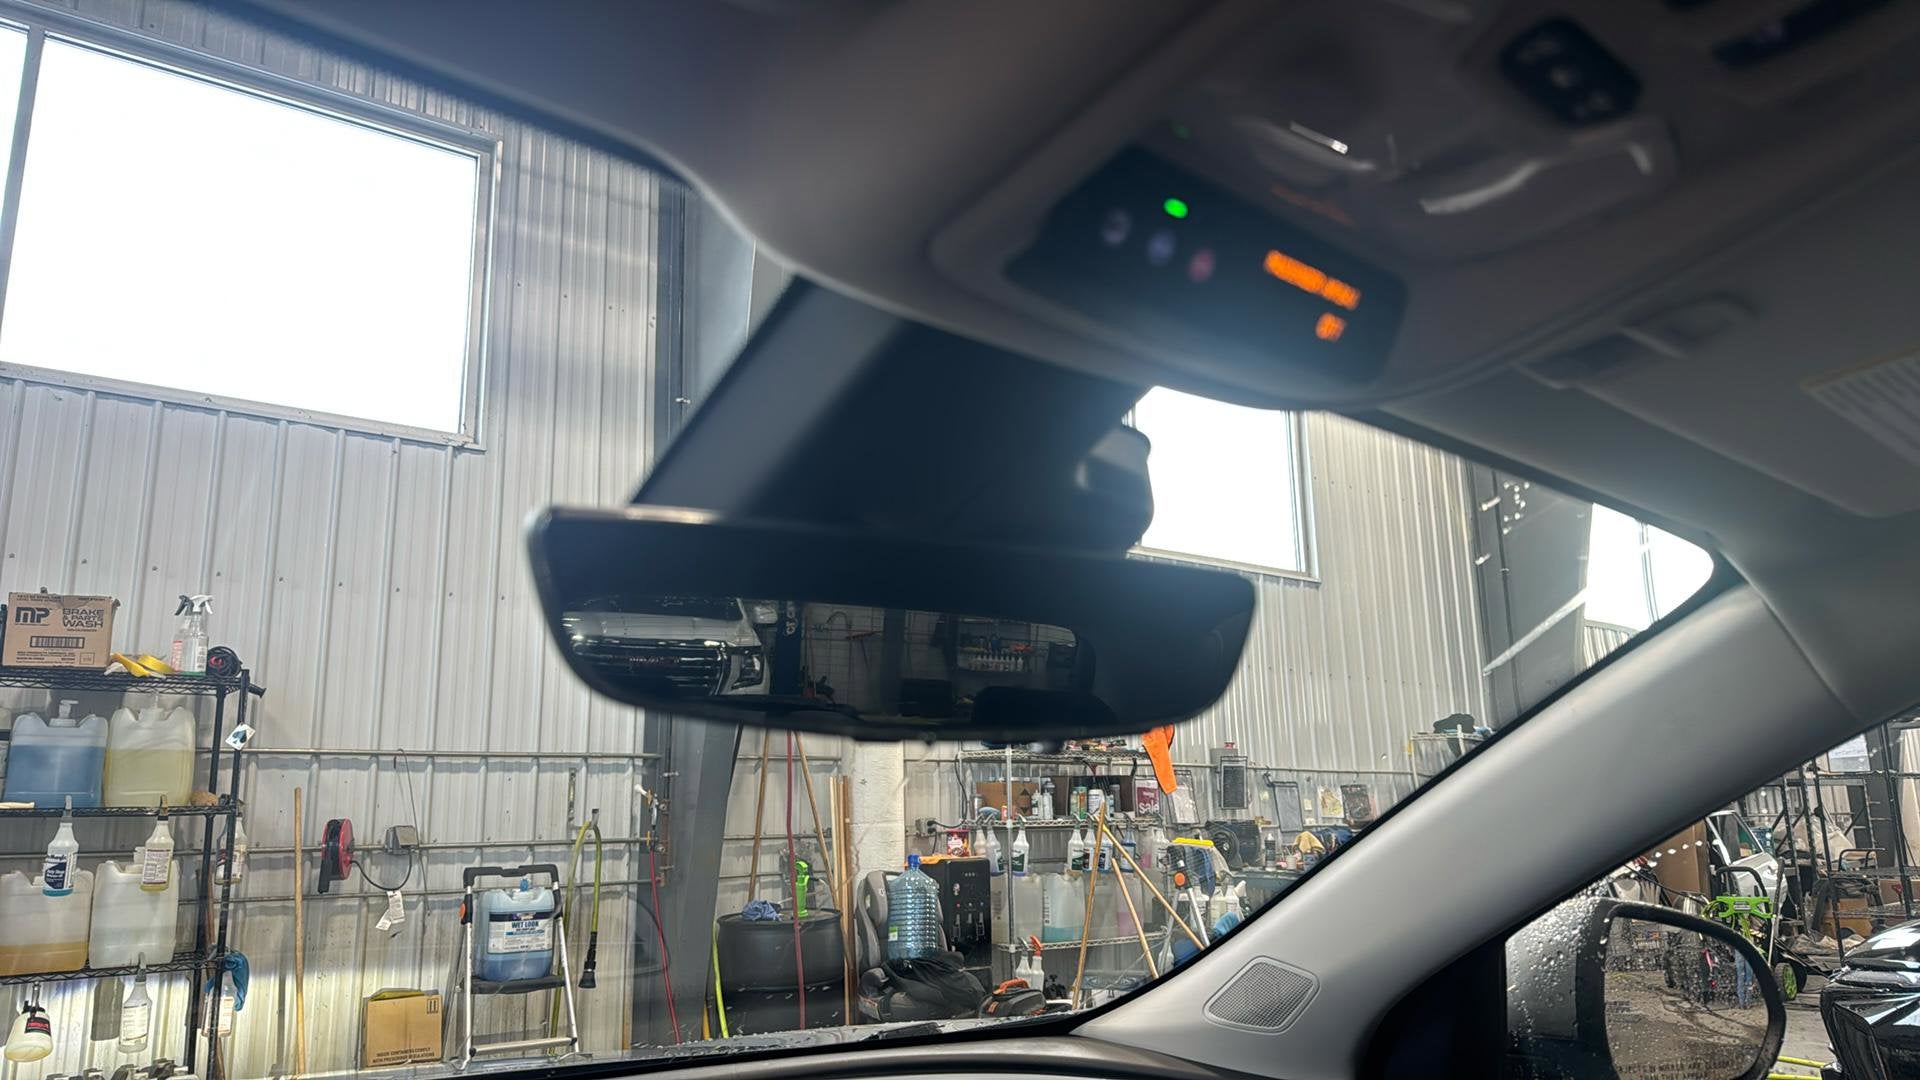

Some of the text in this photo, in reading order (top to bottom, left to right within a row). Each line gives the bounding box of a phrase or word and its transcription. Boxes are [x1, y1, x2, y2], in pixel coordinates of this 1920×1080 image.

[15, 607, 50, 623] MP
[63, 608, 104, 616] BRAKE
[63, 620, 104, 628] WASH
